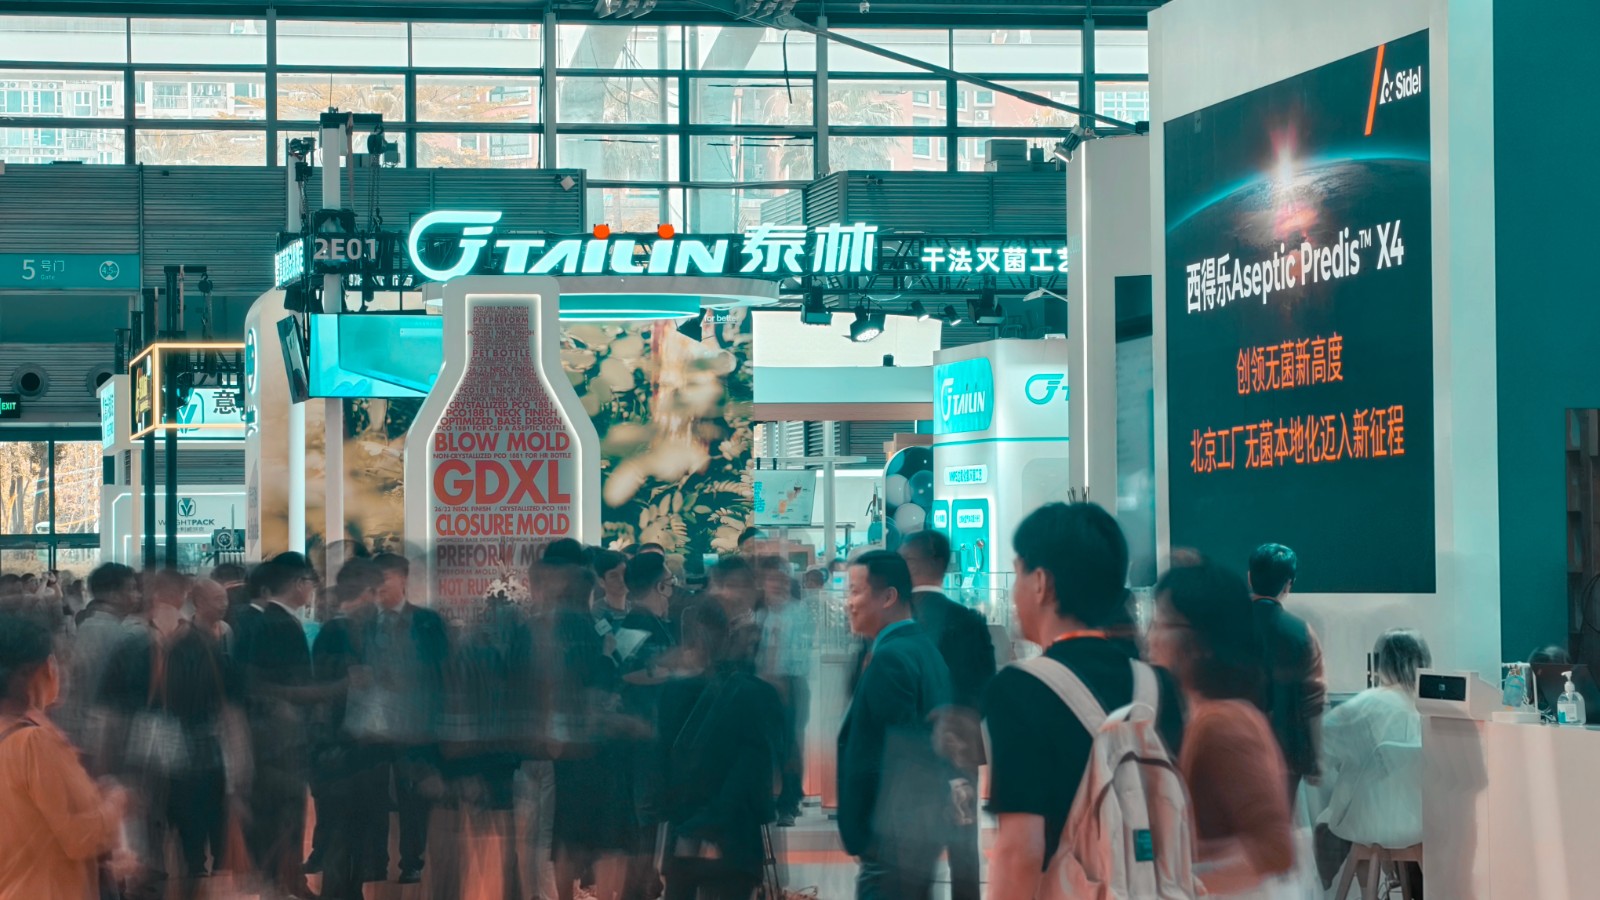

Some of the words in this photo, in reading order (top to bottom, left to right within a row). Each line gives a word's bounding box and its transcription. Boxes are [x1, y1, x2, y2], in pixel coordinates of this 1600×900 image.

[1396, 65, 1421, 99] Sidel
[313, 238, 376, 260] 2E01
[740, 222, 878, 273] 泰林
[22, 259, 35, 280] 5
[41, 260, 65, 272] 号门
[1186, 243, 1296, 314] 西得乐Aseptic
[1376, 220, 1404, 270] X4
[1236, 332, 1343, 394] 创领无菌新高度
[2, 402, 16, 410] EXIT
[212, 390, 237, 414] 意
[440, 418, 493, 426] OPTIMIZED
[498, 418, 522, 426] BASE
[526, 418, 562, 426] DESIGN
[435, 432, 499, 452] BLOW
[507, 432, 570, 452] MOLD
[1190, 405, 1404, 473] 北京工厂无菌本地化迈入新征程
[433, 459, 571, 506] GDXL
[436, 513, 514, 536] CLOSURE
[516, 513, 570, 536] MOLD
[438, 578, 464, 596] HOT
